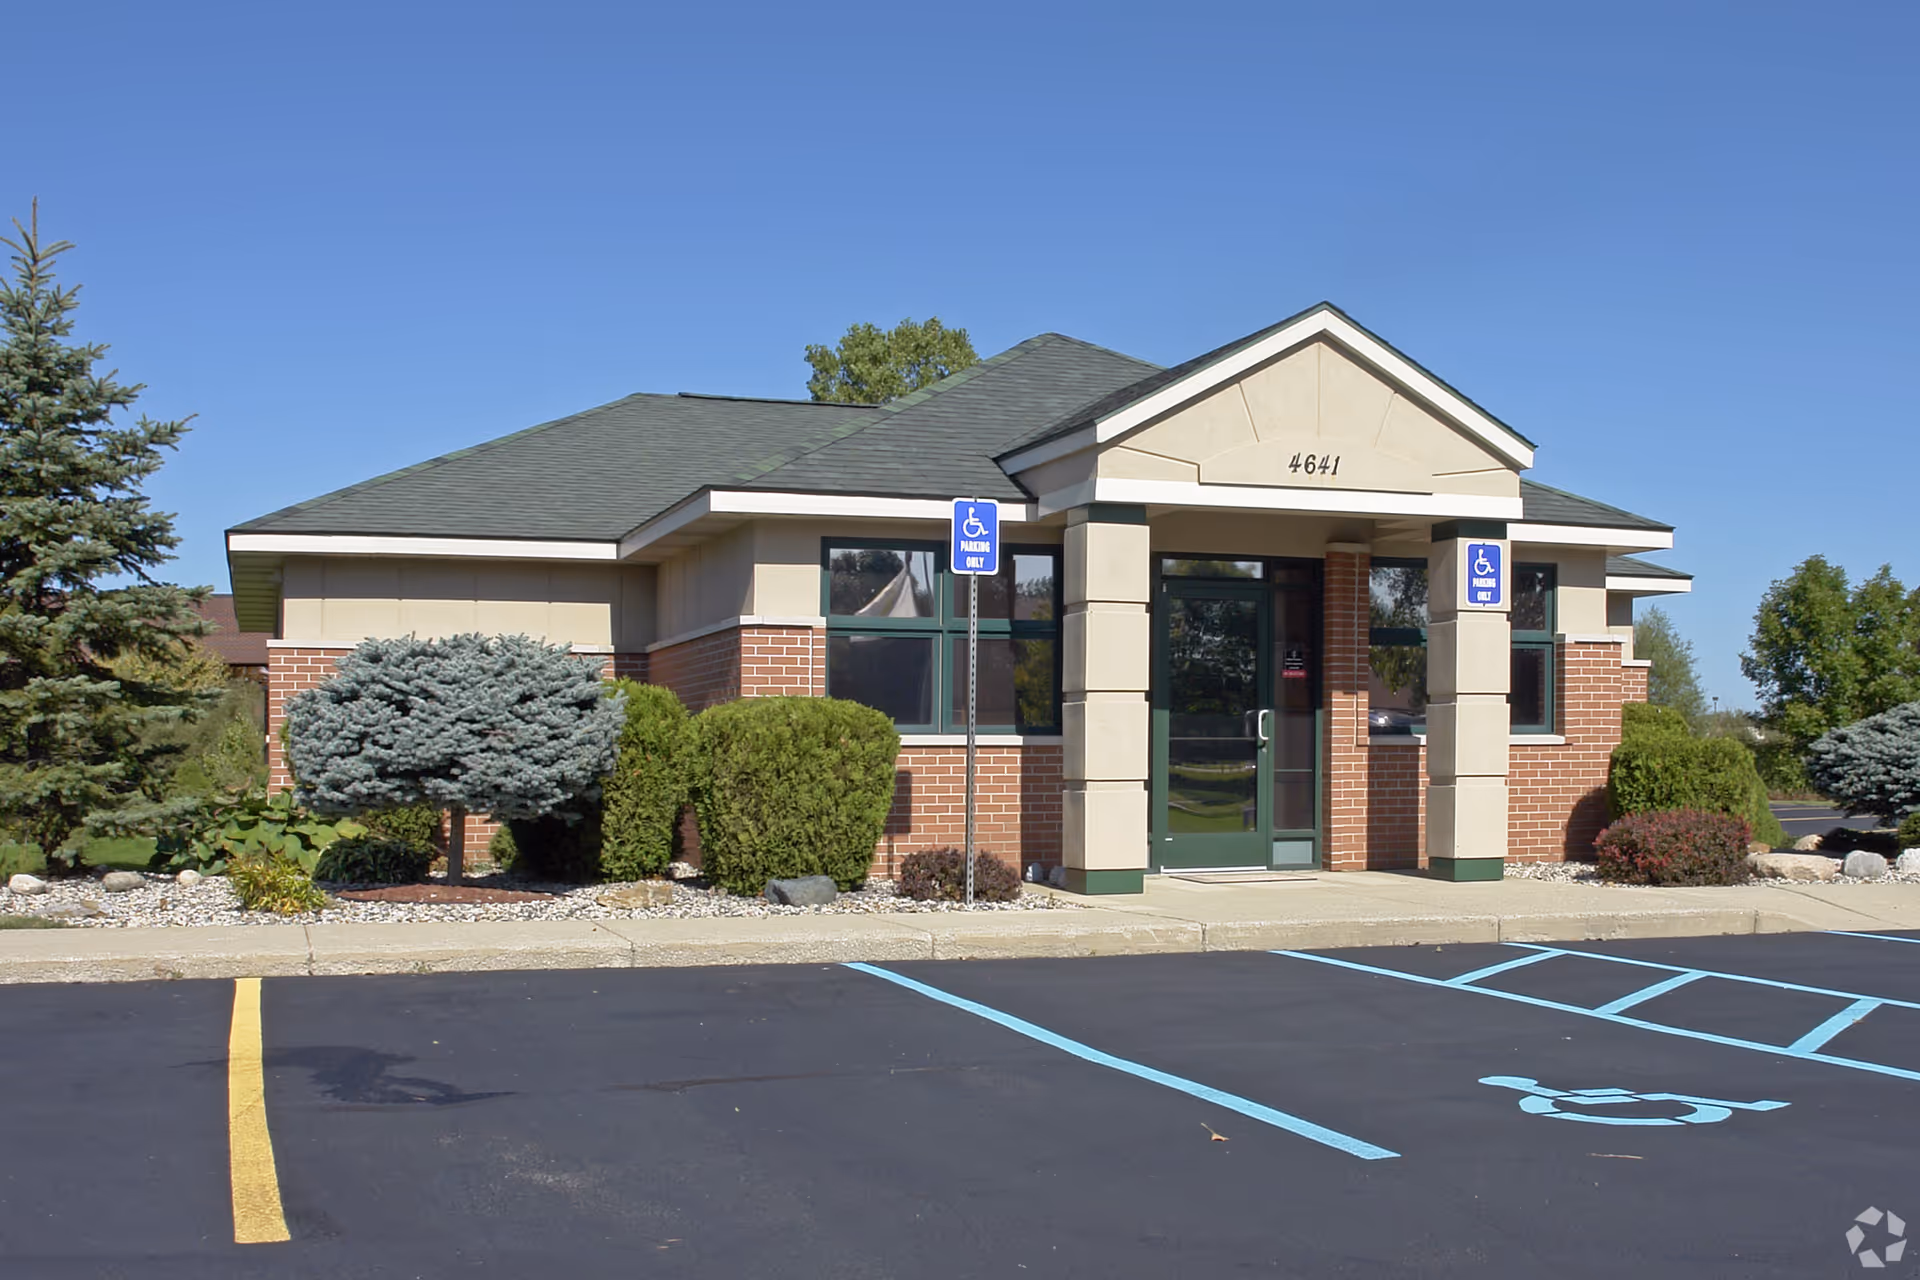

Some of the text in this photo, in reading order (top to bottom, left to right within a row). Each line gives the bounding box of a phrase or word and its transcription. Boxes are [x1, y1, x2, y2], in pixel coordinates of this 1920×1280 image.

[1288, 452, 1341, 475] 4641
[960, 540, 990, 553] PARKING
[966, 556, 984, 568] ONLY
